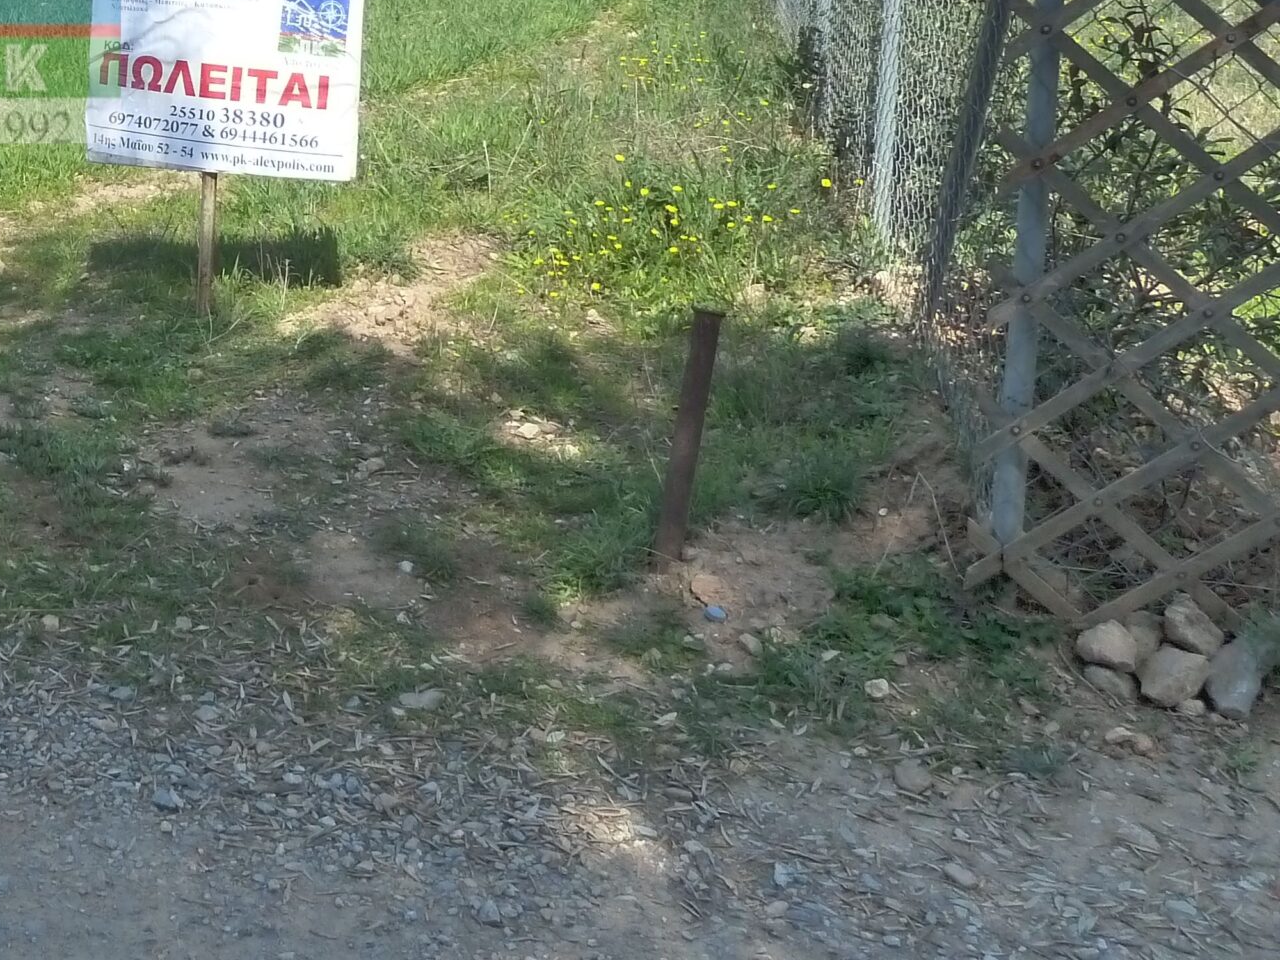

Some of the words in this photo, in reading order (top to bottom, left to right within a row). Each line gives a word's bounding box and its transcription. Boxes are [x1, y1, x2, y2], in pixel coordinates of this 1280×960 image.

[99, 52, 330, 110] ΠΩΛΕΙΤΑΙ
[108, 111, 199, 138] 6974072077
[202, 124, 216, 138] &
[220, 126, 319, 149] 6944461566
[169, 105, 216, 122] 25510
[220, 107, 286, 129] 38380
[156, 142, 170, 155] 52
[180, 145, 194, 159] 54
[201, 151, 335, 174] www.pk-alexpolis.com
